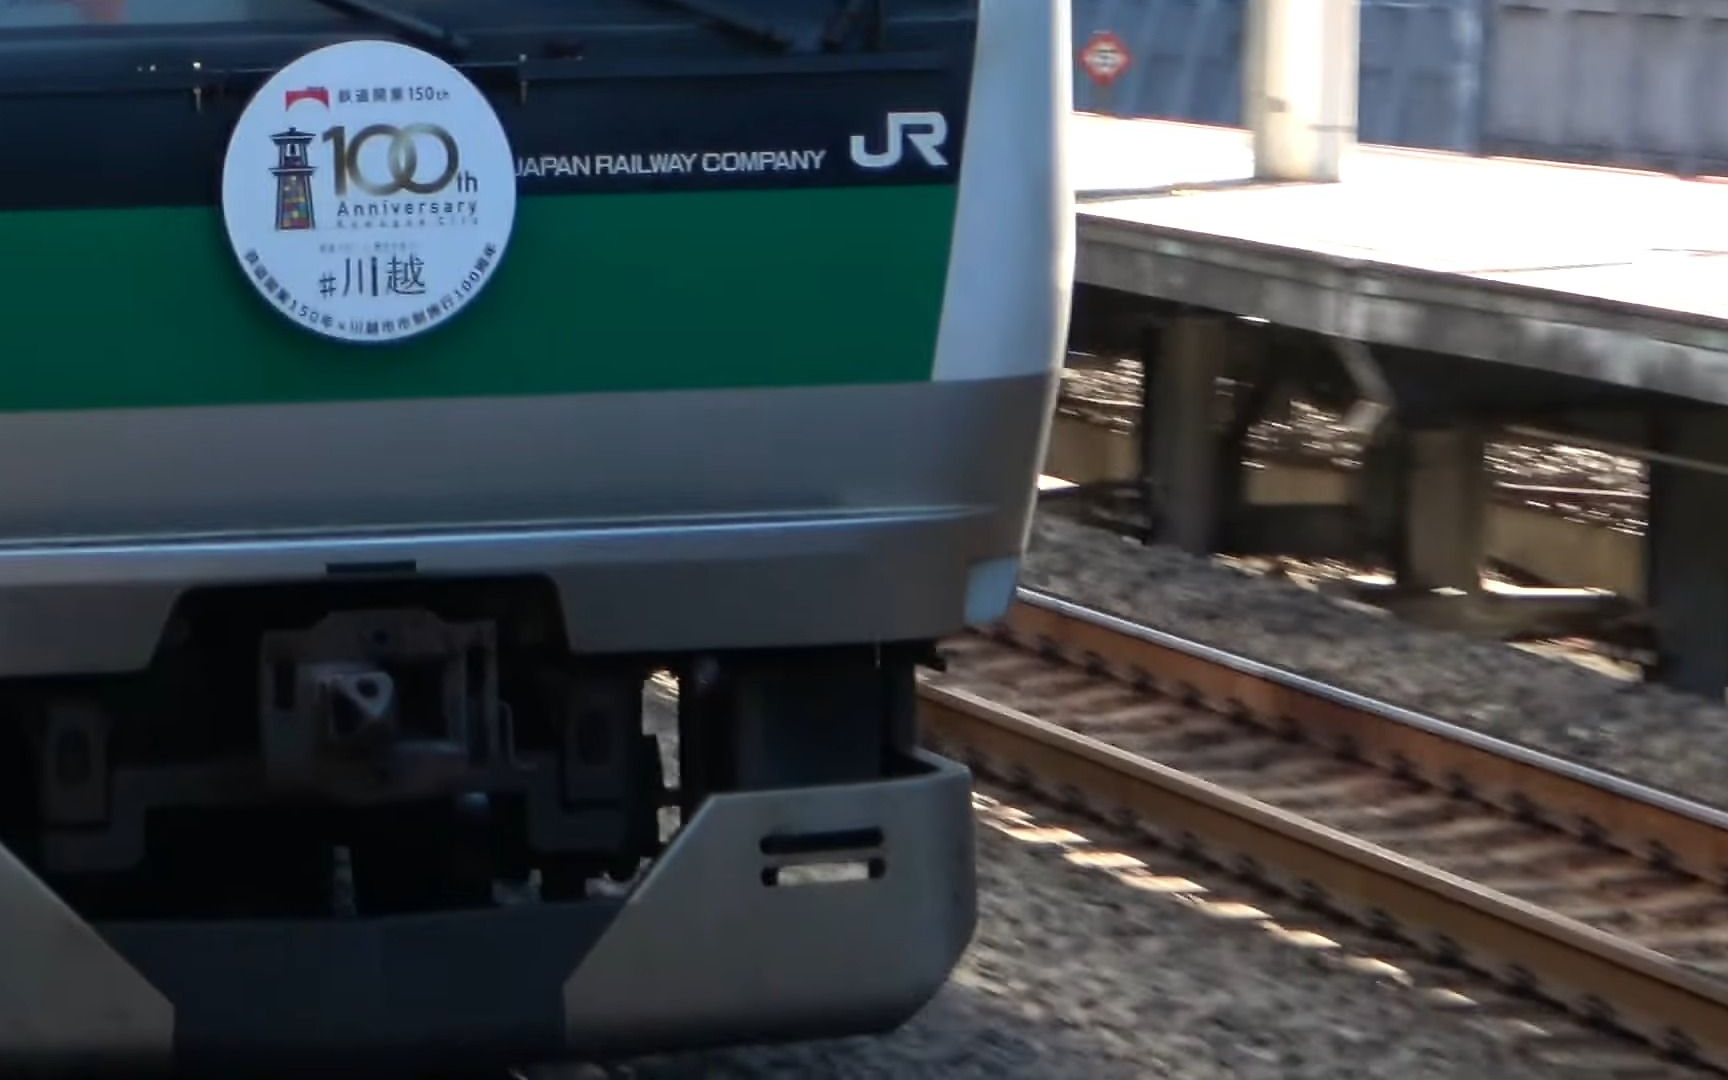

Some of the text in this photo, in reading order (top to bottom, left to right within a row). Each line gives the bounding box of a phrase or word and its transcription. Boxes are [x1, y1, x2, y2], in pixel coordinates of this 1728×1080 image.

[850, 112, 948, 167] JR
[595, 153, 697, 174] RAILWAY
[701, 150, 826, 172] COMPANY
[337, 200, 478, 217] Anniversary
[319, 254, 426, 298] #川越
